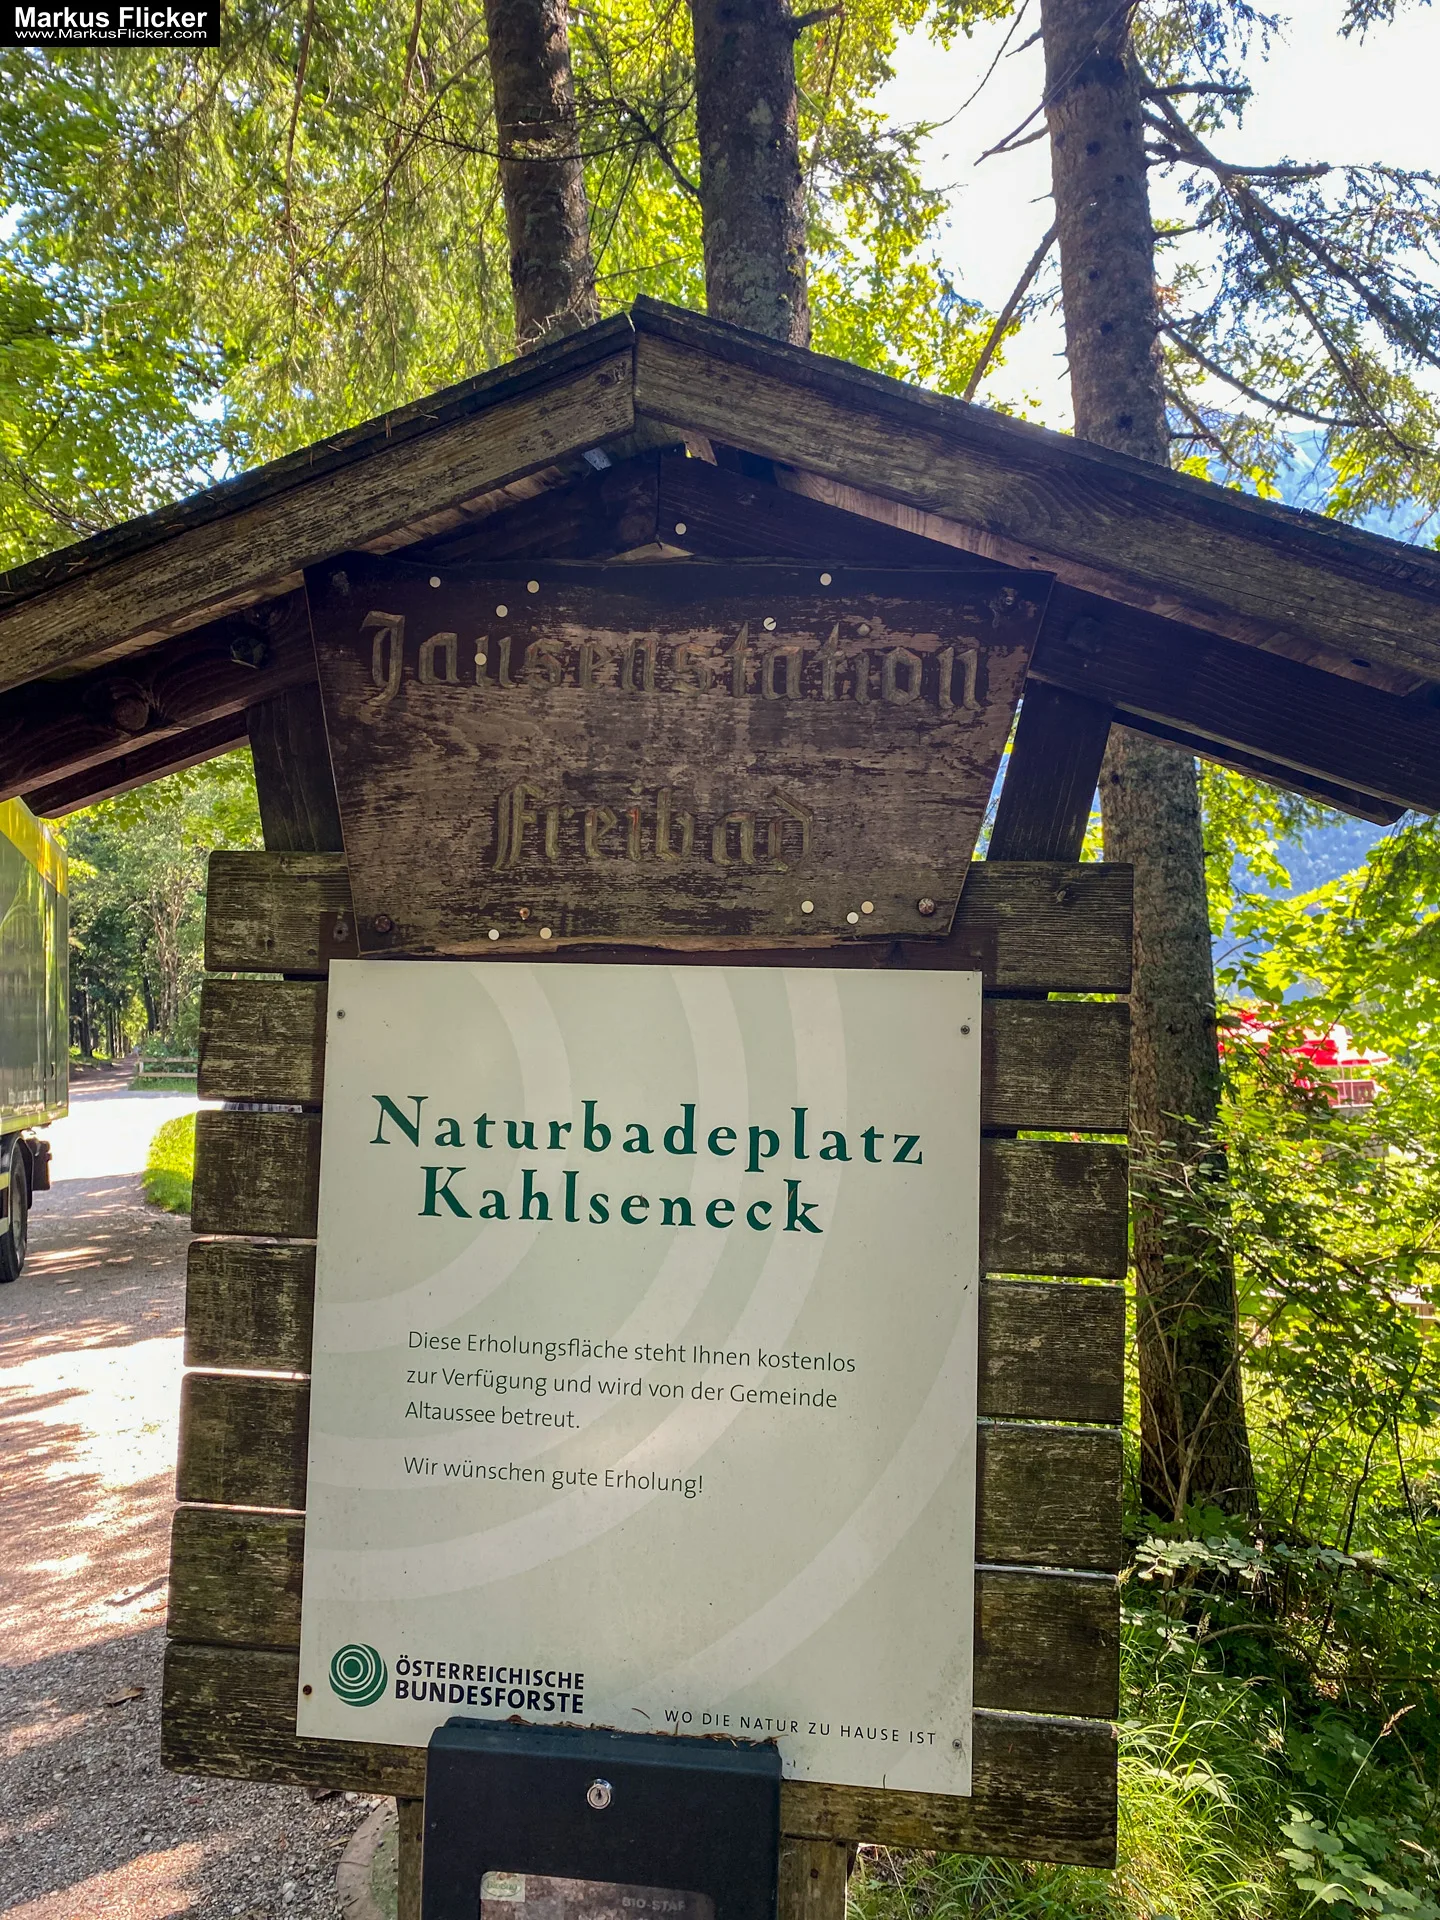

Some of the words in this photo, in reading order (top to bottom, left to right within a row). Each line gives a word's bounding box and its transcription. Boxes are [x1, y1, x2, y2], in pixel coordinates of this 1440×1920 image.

[361, 610, 983, 709] Jausenstation
[369, 1094, 924, 1173] Naturbadeplatz
[417, 1165, 824, 1234] Kahlseneck
[408, 1331, 461, 1351] Diese
[467, 1334, 628, 1362] Erholungsfläche
[634, 1343, 686, 1363] steht
[693, 1345, 750, 1366] Ihnen
[758, 1348, 856, 1373] kostenlos
[406, 1369, 438, 1385] zur
[442, 1368, 547, 1397] Verfügung
[553, 1375, 591, 1393] und
[598, 1377, 642, 1397] wird
[649, 1383, 684, 1399] von
[691, 1381, 724, 1401] der
[730, 1384, 838, 1408] Gemeinde
[405, 1401, 496, 1424] Altaussee
[501, 1406, 580, 1429] betreut.
[404, 1456, 438, 1476] Wir
[443, 1460, 545, 1483] wünschen
[552, 1468, 598, 1490] gute
[604, 1469, 703, 1499] Erholung!
[395, 1654, 585, 1690] ÖSTERREICHISCHE
[395, 1679, 584, 1714] BUNDESFORSTE
[664, 1709, 693, 1724] WO
[702, 1713, 731, 1728] DIE
[740, 1716, 799, 1733] NATUR
[808, 1722, 831, 1736] ZU
[840, 1725, 900, 1742] HAUSE
[909, 1731, 937, 1745] IST
